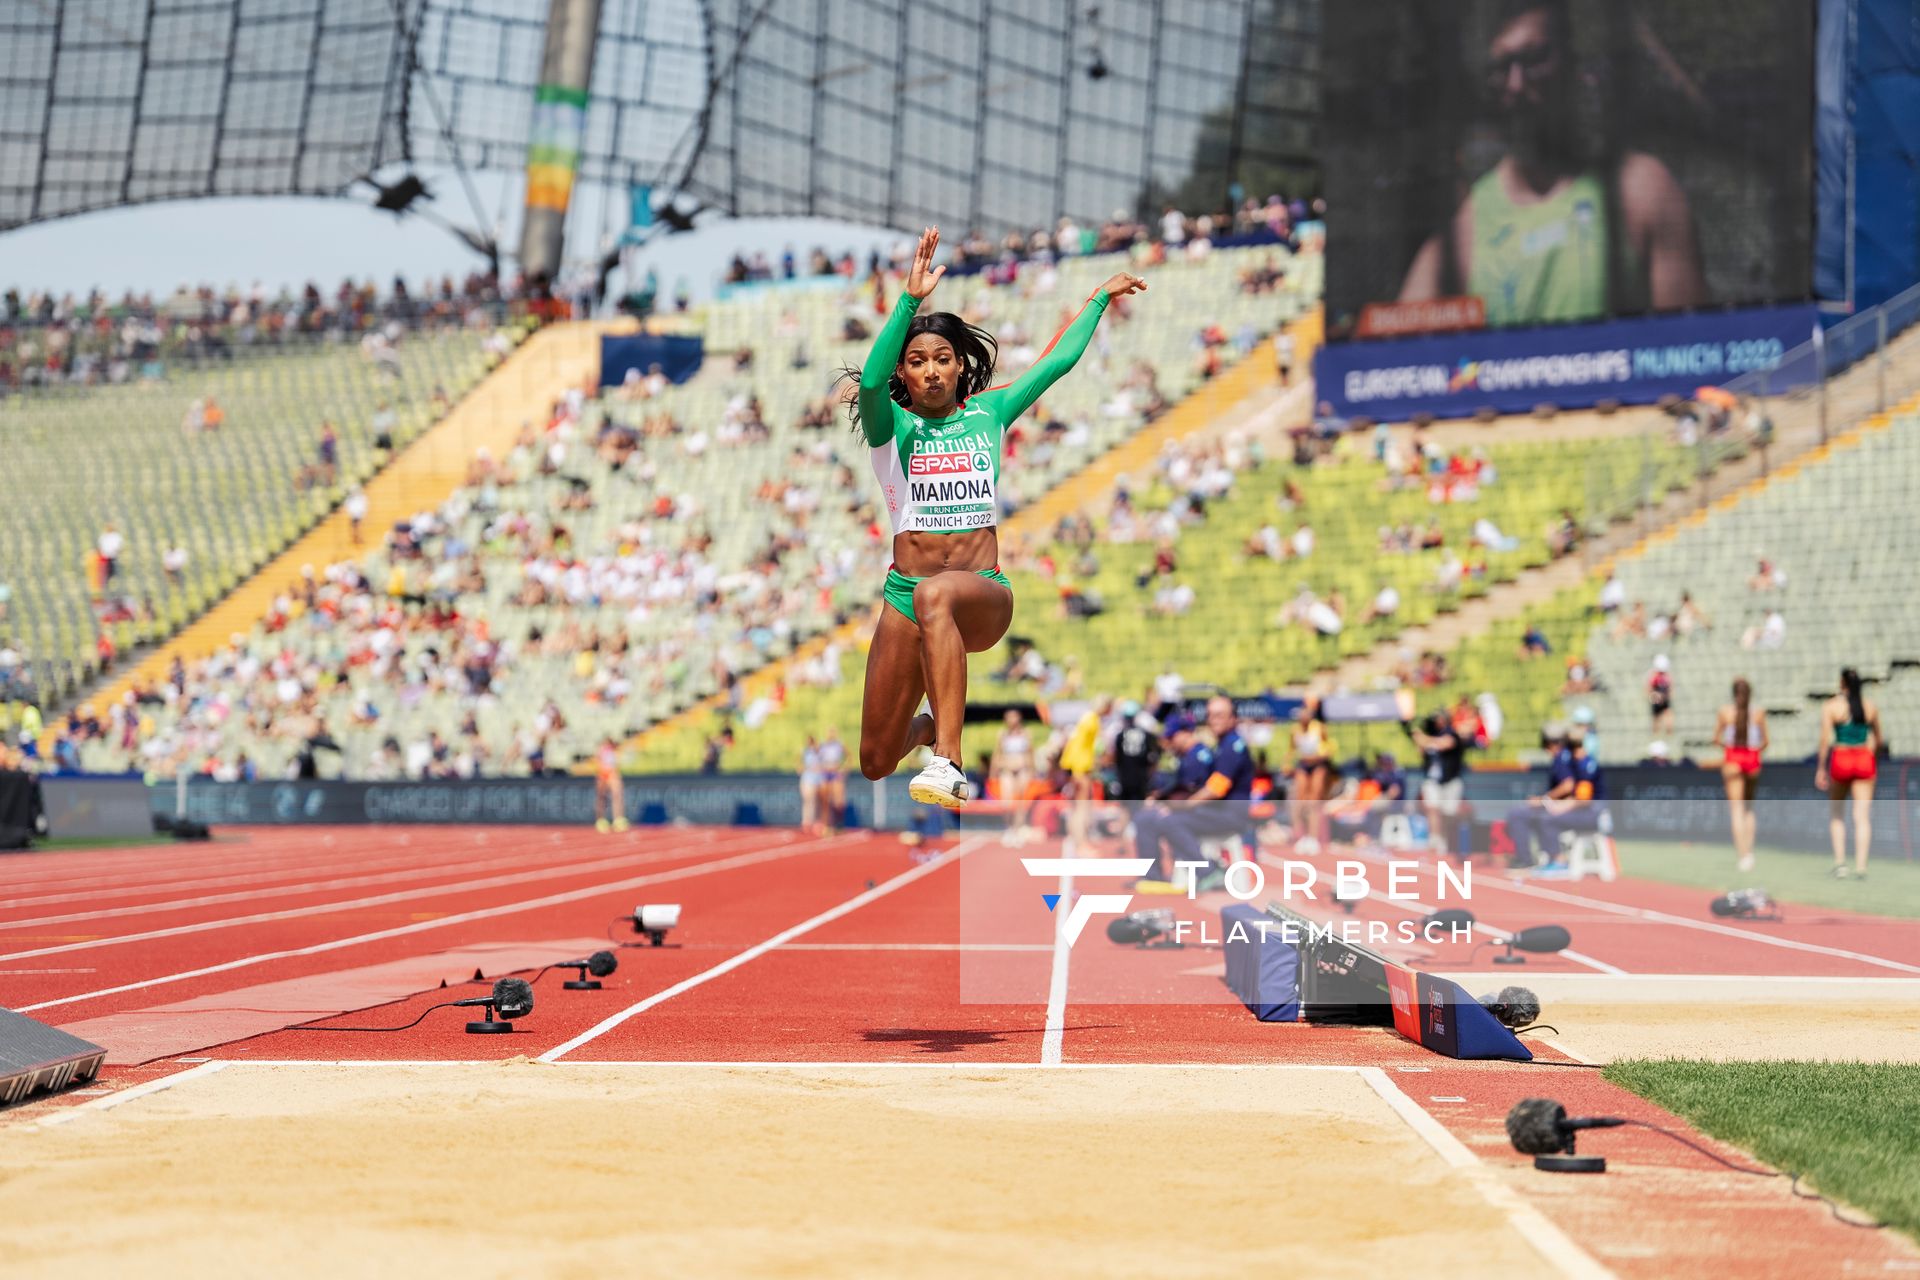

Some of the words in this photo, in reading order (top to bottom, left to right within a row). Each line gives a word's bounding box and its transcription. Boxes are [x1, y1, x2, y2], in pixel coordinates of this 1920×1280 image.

[1345, 366, 1449, 402] EUROPEAN
[1477, 349, 1631, 392] CHAMPIONSHIPS
[1633, 342, 1722, 379] MUNICH
[1724, 338, 1783, 372] 2022
[913, 431, 994, 454] PORTUGAL
[911, 455, 971, 472] SPAR
[911, 479, 993, 502] MAMONA
[915, 516, 963, 527] MUNICH
[966, 513, 992, 526] 2022
[934, 506, 951, 514] RUN
